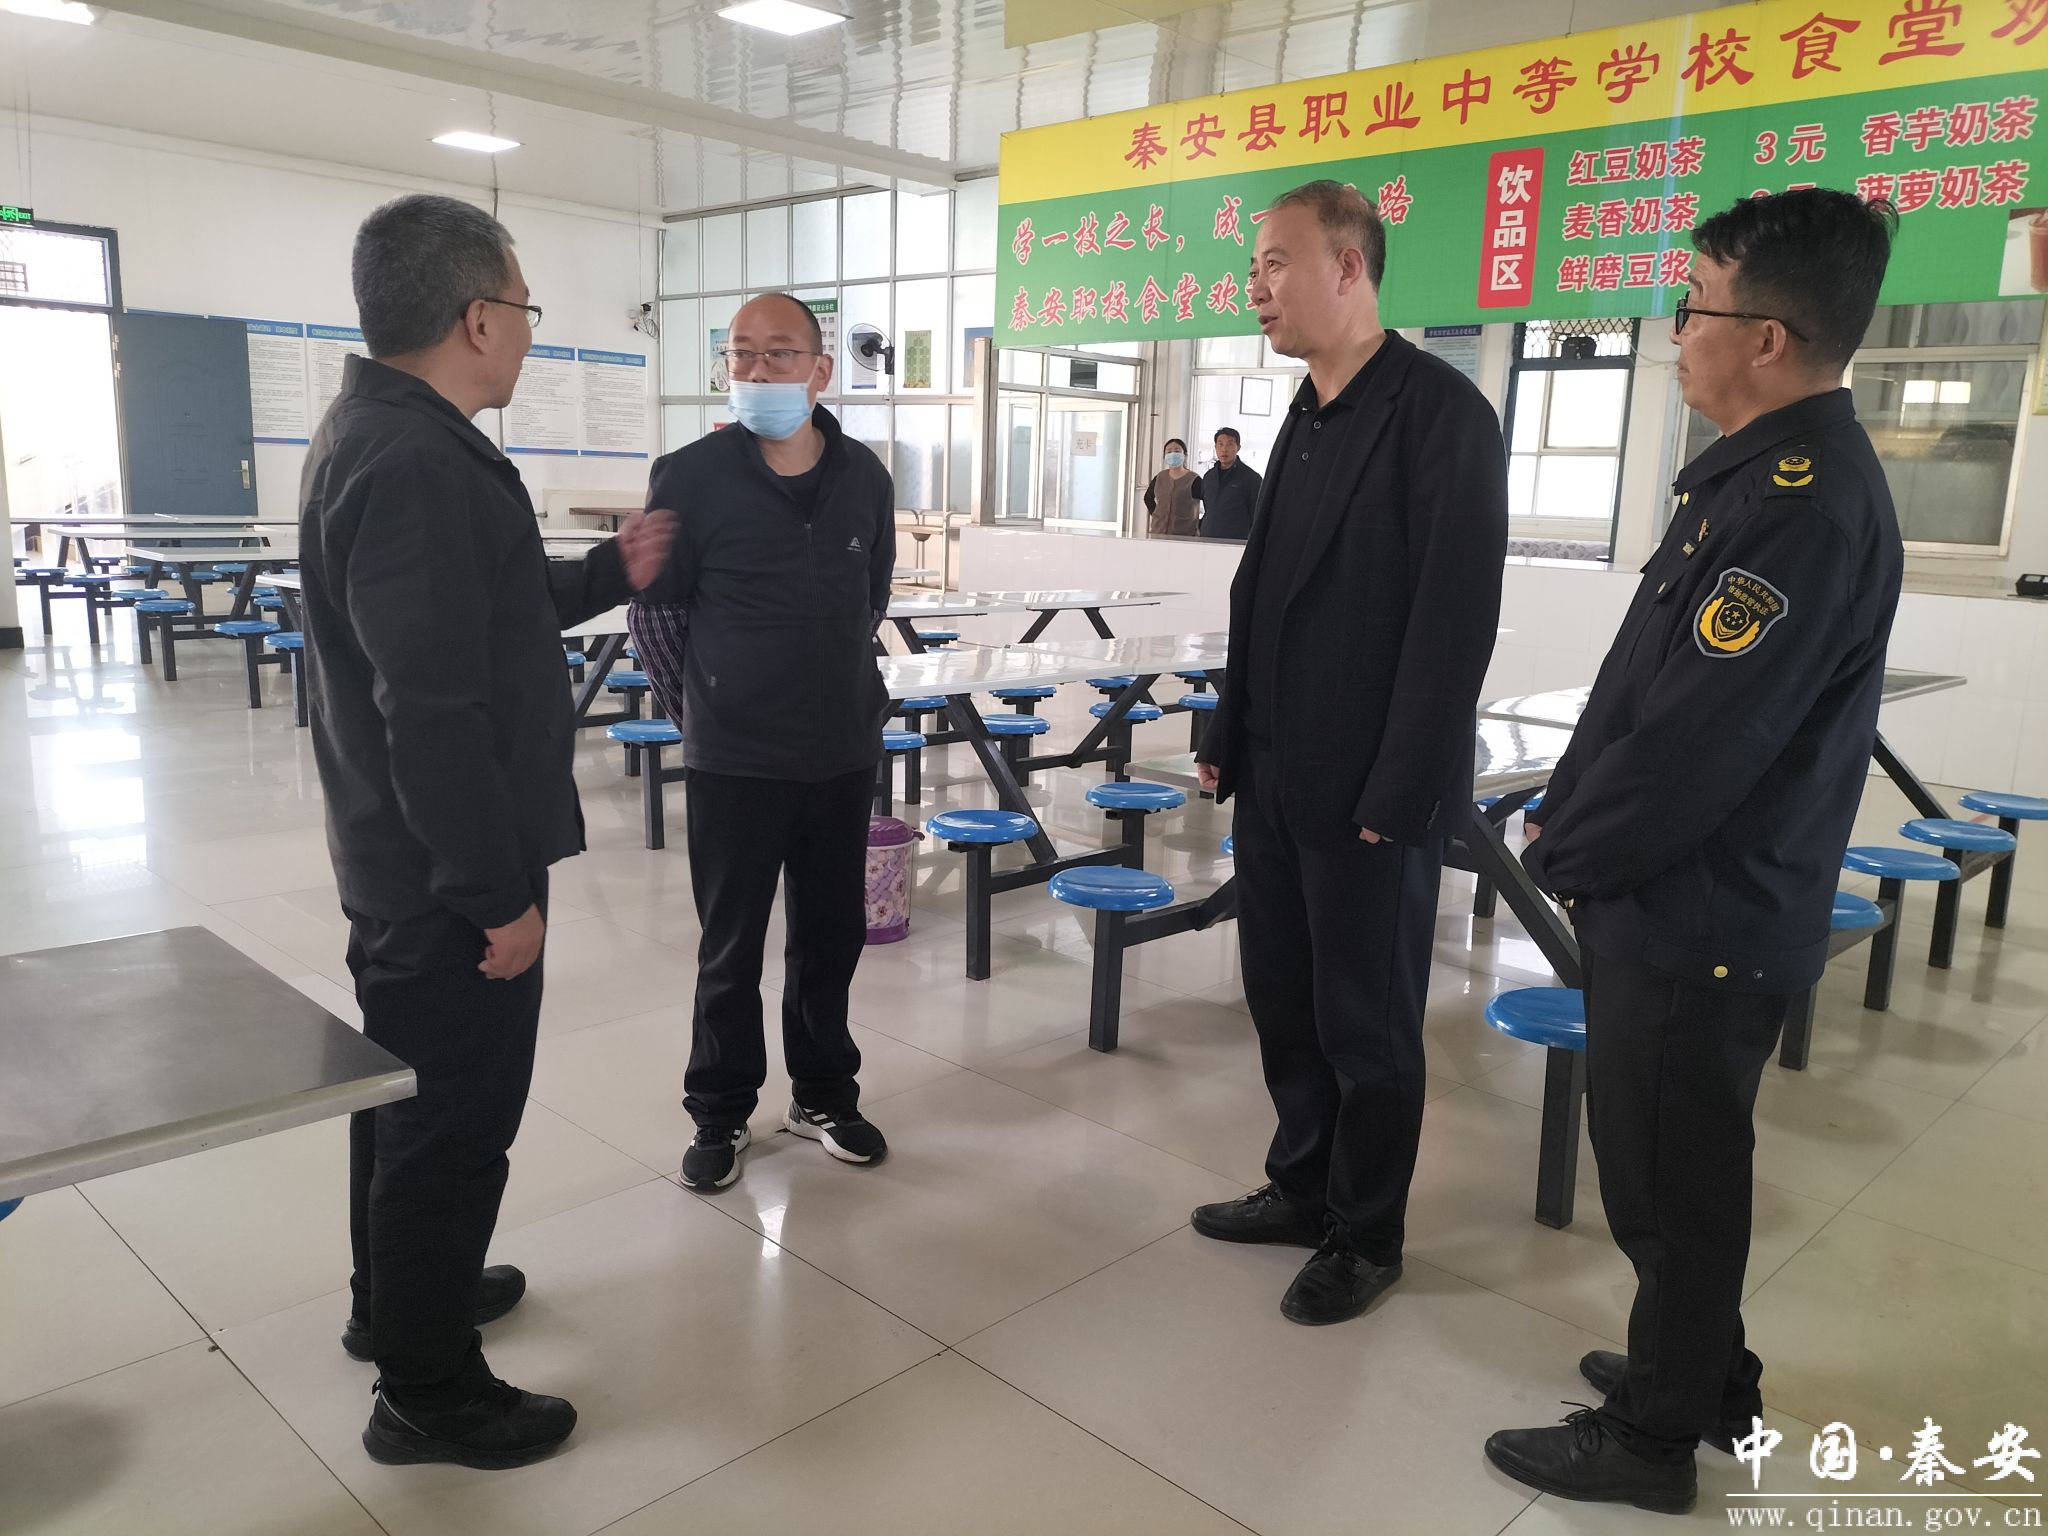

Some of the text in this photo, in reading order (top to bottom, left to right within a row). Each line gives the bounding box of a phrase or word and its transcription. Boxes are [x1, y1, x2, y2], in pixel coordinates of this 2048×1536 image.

[1566, 136, 1706, 187] 红豆奶茶
[1859, 96, 2039, 157] 香芋奶茶
[1489, 163, 1534, 293] 饮品区
[1562, 159, 2031, 242] 麦香奶茶 菠萝奶茶
[1556, 248, 1693, 294] 鲜磨豆浆
[1728, 576, 1779, 611] 中华人民共和国
[1728, 585, 1769, 615] 市场监管执法
